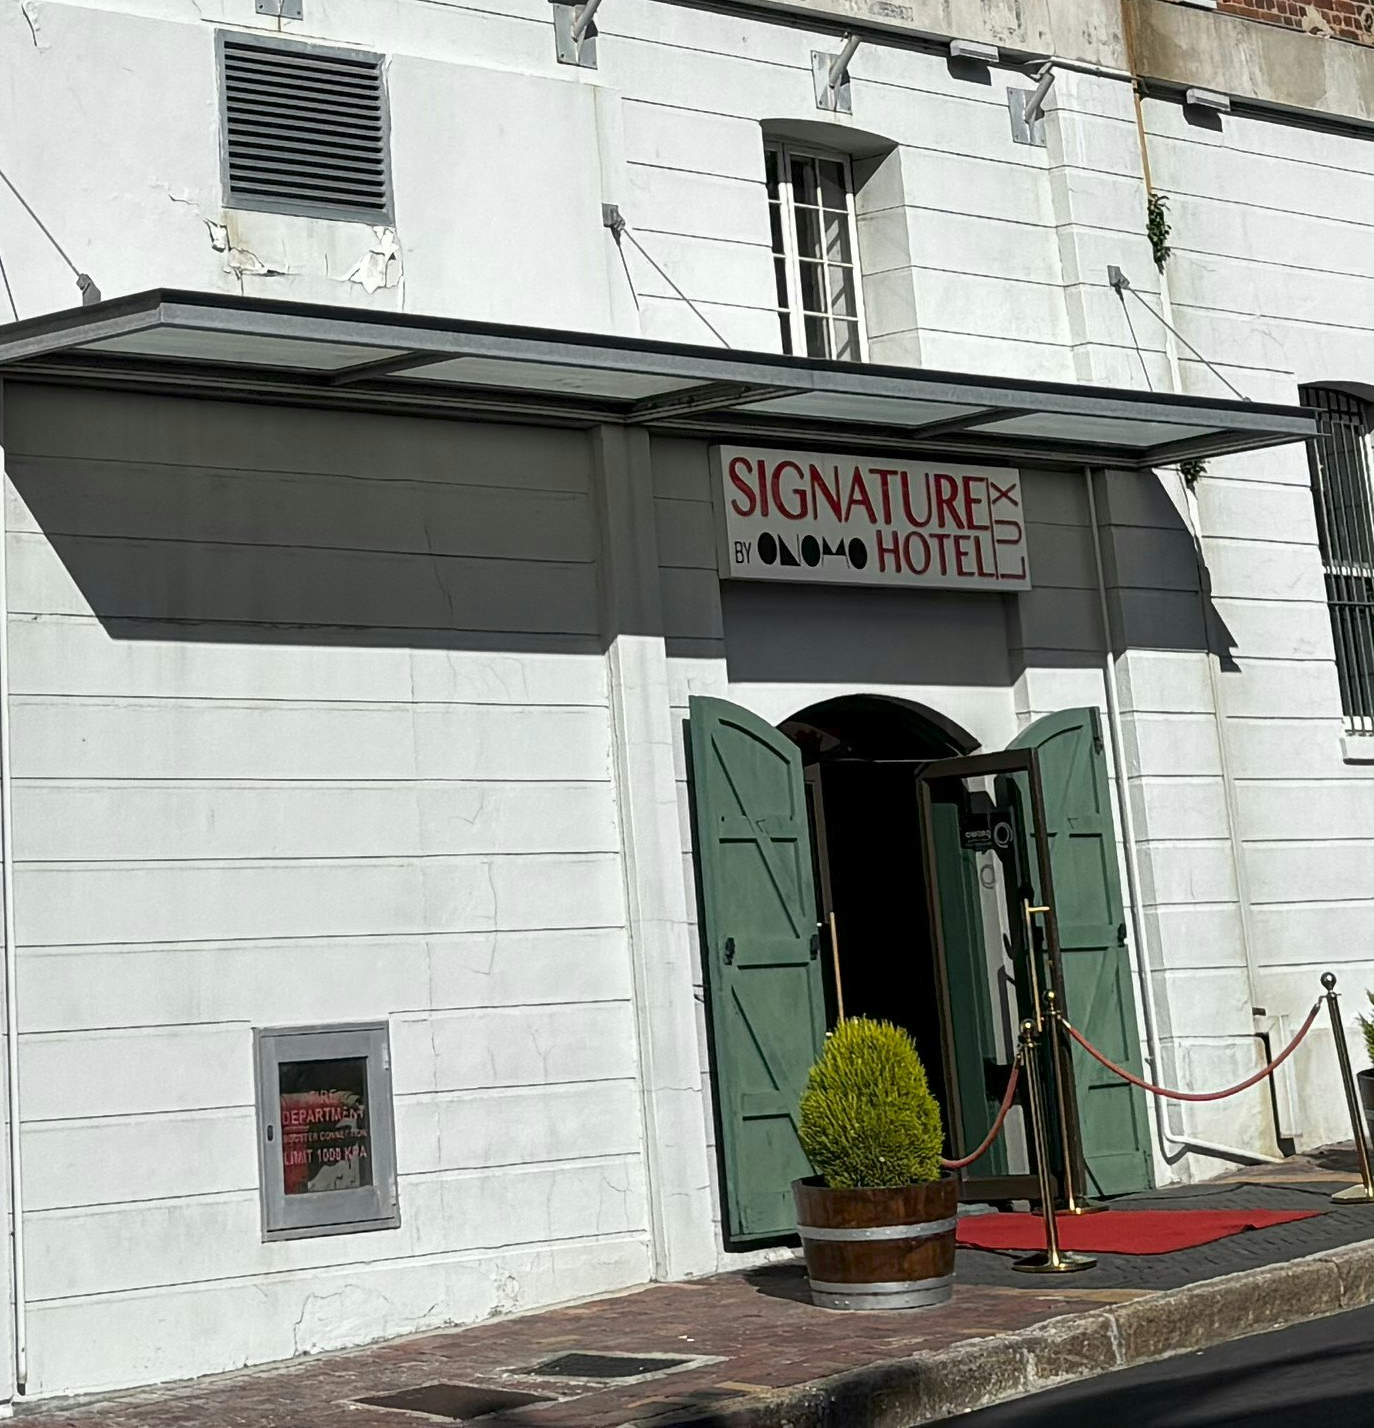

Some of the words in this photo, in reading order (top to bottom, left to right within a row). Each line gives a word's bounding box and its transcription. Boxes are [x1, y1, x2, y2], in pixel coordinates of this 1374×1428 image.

[728, 456, 990, 531] SIGNATURE
[734, 540, 753, 565] BY
[876, 529, 997, 578] HOTEL
[989, 481, 1026, 581] LUX
[282, 1105, 365, 1124] DEPARTMENT
[284, 1150, 313, 1165] LIMIT
[317, 1147, 341, 1162] 1000
